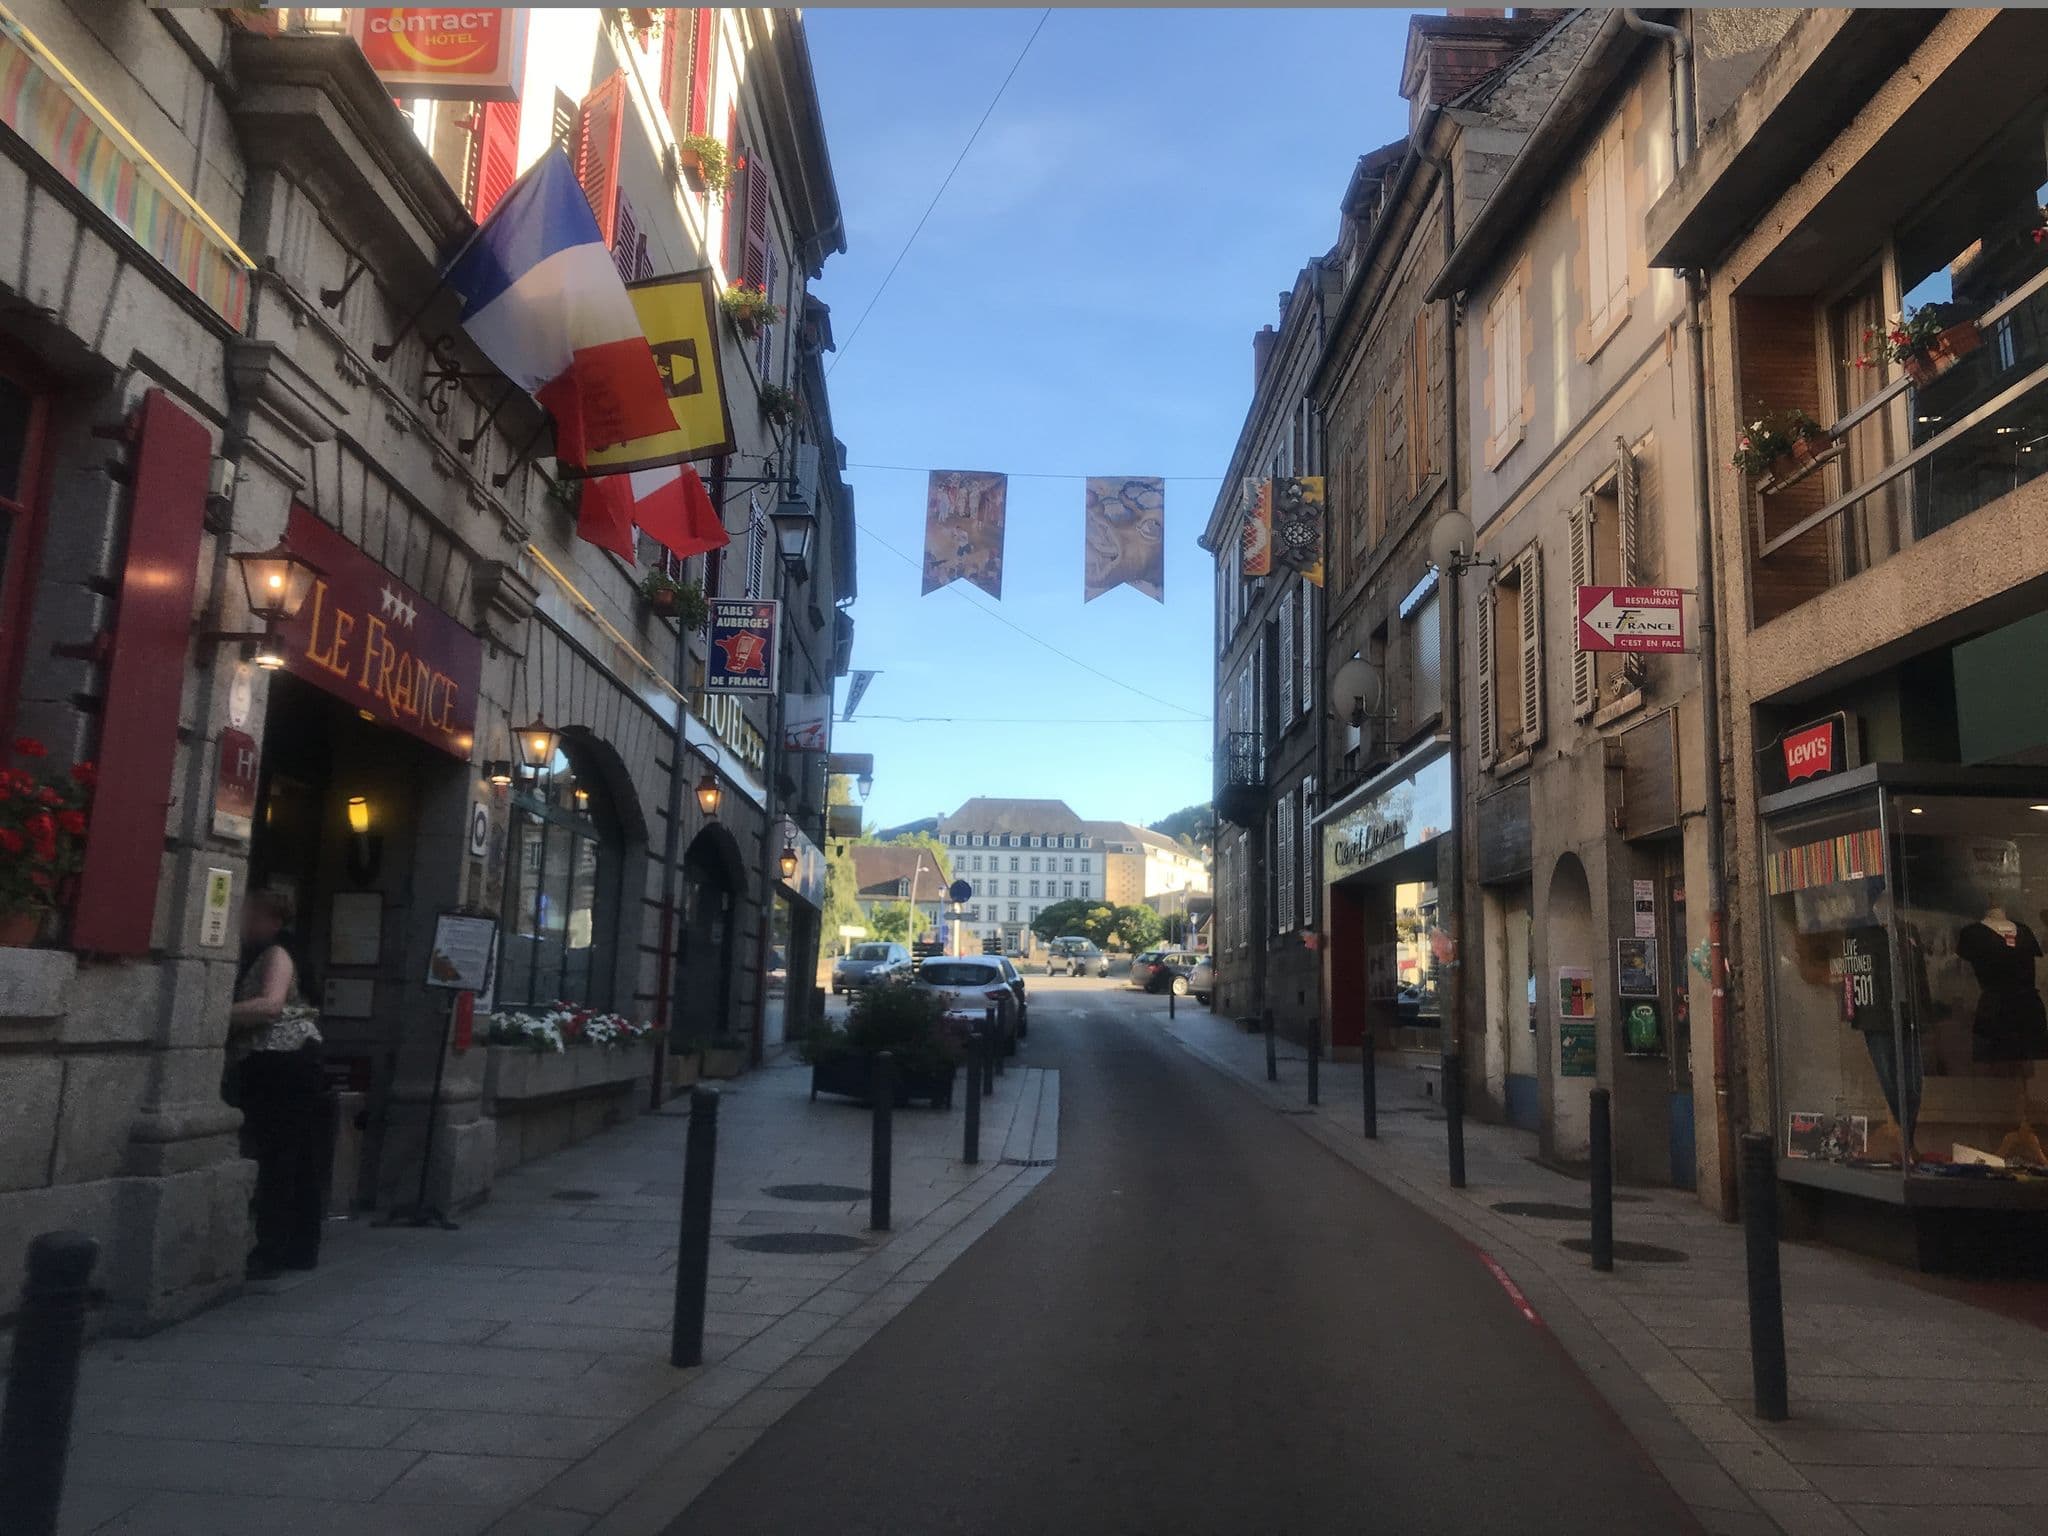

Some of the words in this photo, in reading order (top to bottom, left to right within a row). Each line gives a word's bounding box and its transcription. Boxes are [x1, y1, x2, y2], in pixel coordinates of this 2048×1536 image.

[1652, 589, 1679, 597] HOTEL
[1625, 597, 1680, 605] RESTAURANT
[717, 605, 754, 616] TABLES
[716, 617, 769, 629] AUBERGES
[1598, 621, 1613, 629] LE
[711, 676, 725, 686] DE
[728, 676, 768, 687] FRANCE
[1843, 938, 1858, 956] LIVE
[1853, 974, 1874, 1006] 501
